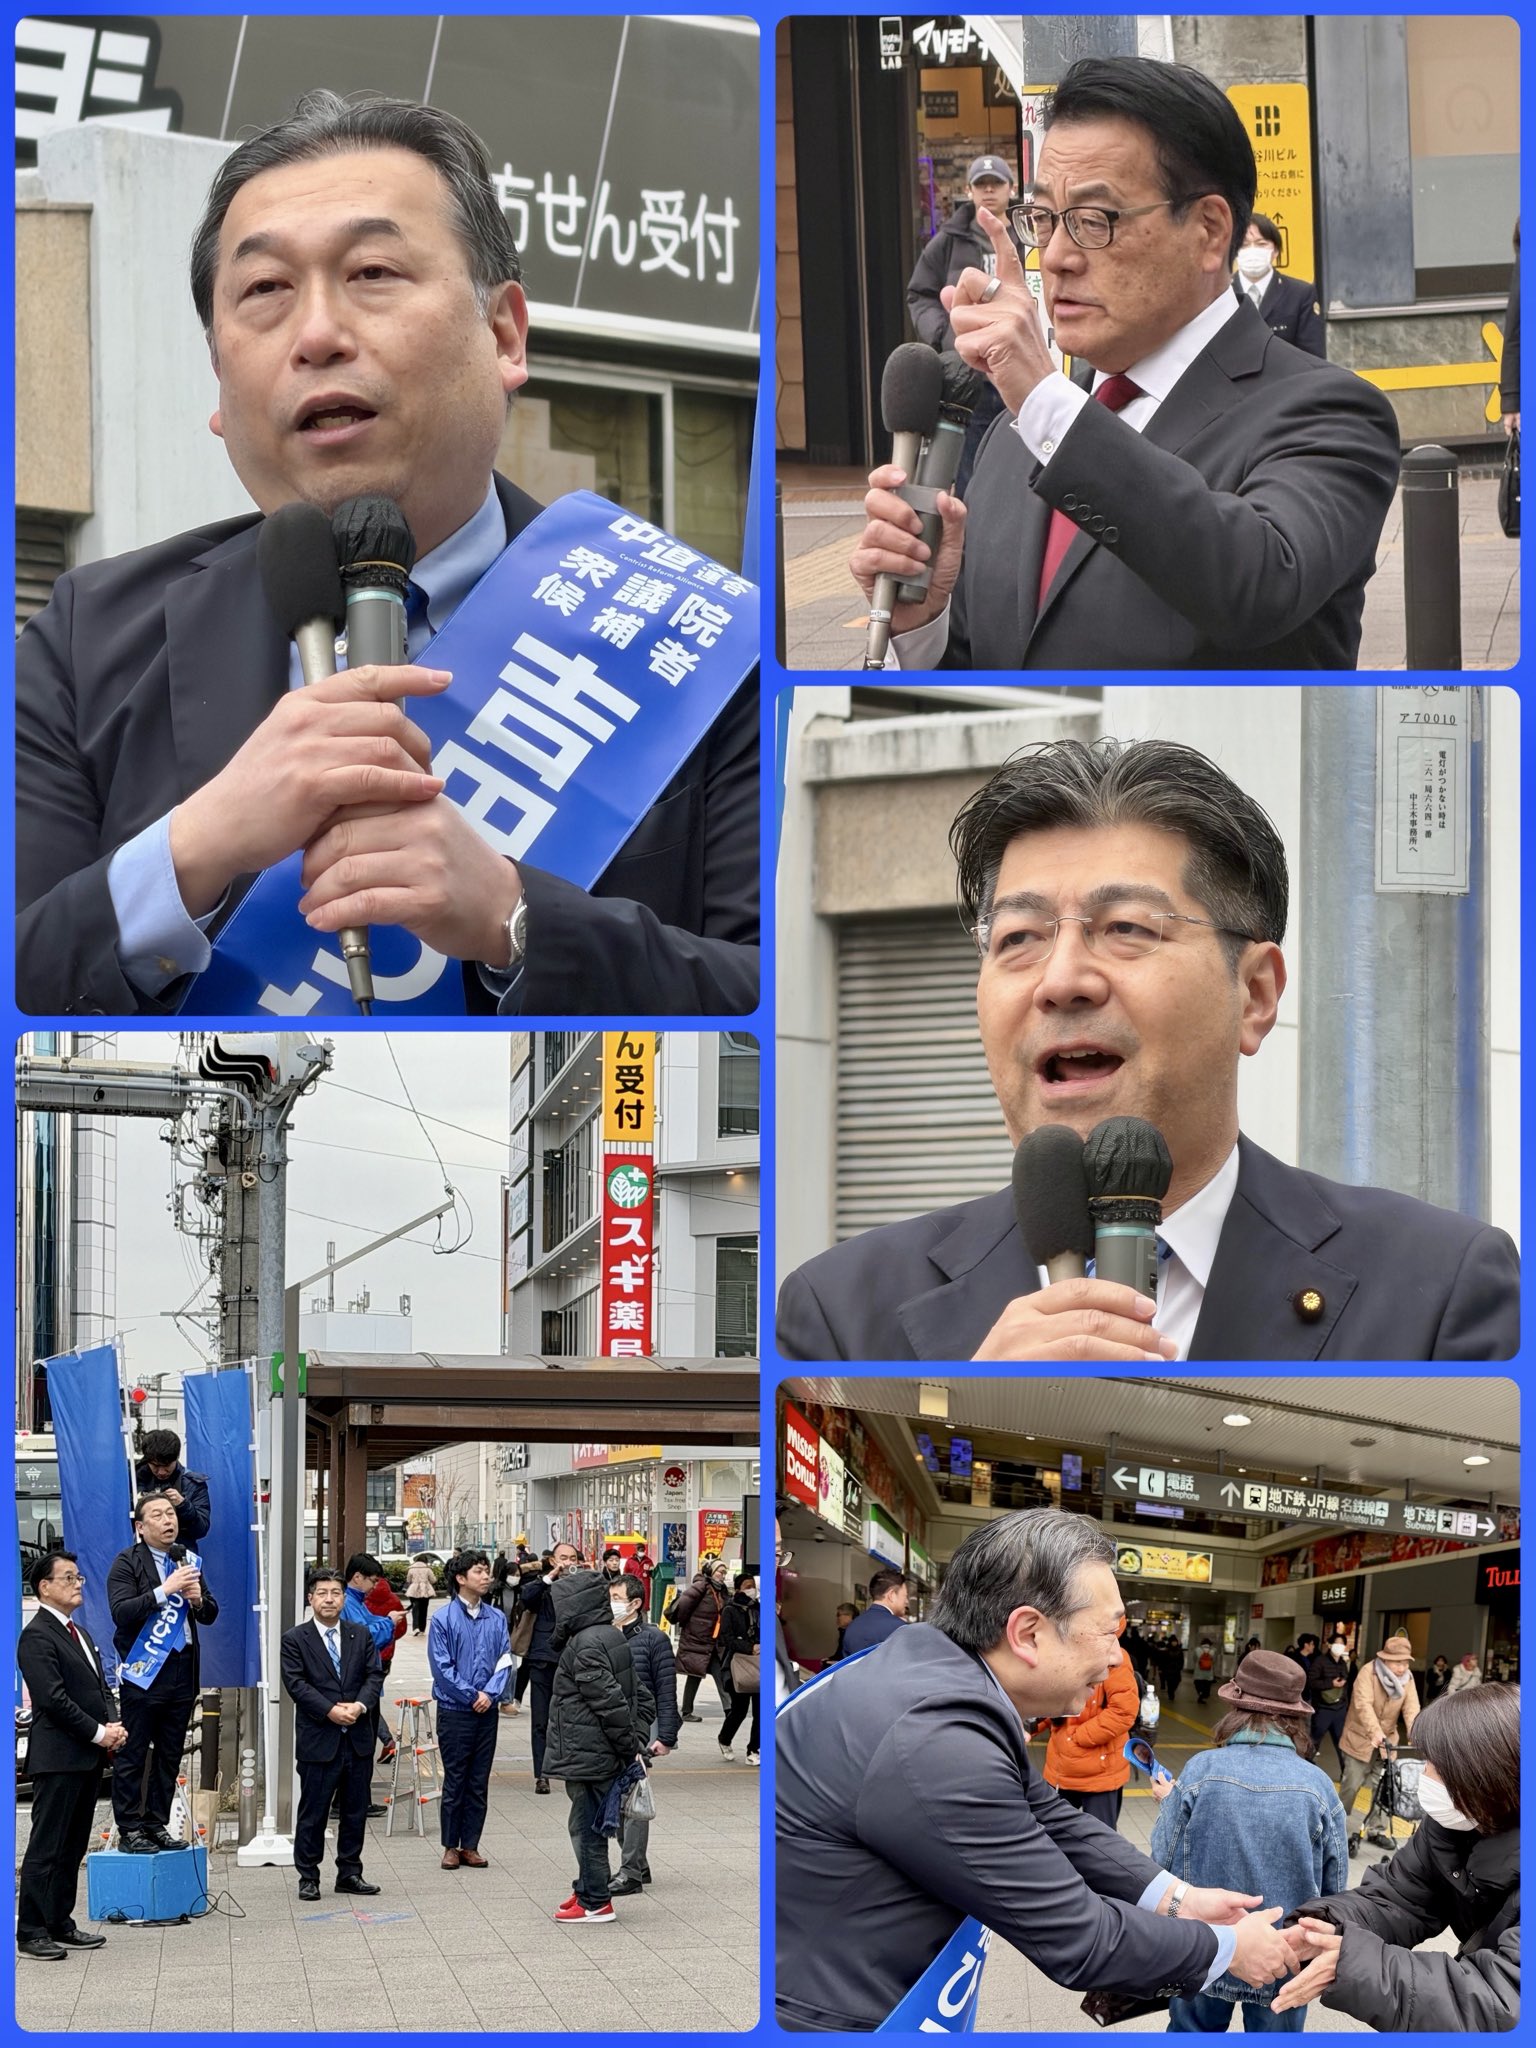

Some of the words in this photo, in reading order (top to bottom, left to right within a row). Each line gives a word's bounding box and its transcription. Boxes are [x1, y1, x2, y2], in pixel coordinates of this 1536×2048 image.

[881, 56, 902, 70] LAB
[491, 162, 740, 284] 方せん受付
[619, 553, 648, 571] Centrist
[648, 565, 675, 579] Reform
[676, 575, 705, 591] Alliance
[559, 546, 734, 648] 衆議院
[532, 571, 701, 687] 候補者
[1438, 750, 1447, 829] 電灯がつかない時は
[614, 1031, 645, 1130] ん受付
[786, 1423, 817, 1466] Mister
[1166, 1473, 1195, 1492] 電話
[1166, 1488, 1200, 1501] Telephone
[1269, 1488, 1306, 1507] 地下鉄
[1307, 1493, 1340, 1511] JR線
[1268, 1502, 1302, 1518] Subway
[1306, 1508, 1319, 1519] JR
[1320, 1509, 1338, 1521] Line
[1370, 1515, 1385, 1527] Line
[1403, 1505, 1437, 1523] 地下鉄
[1405, 1520, 1437, 1533] Subway
[1321, 1587, 1347, 1601] BASE
